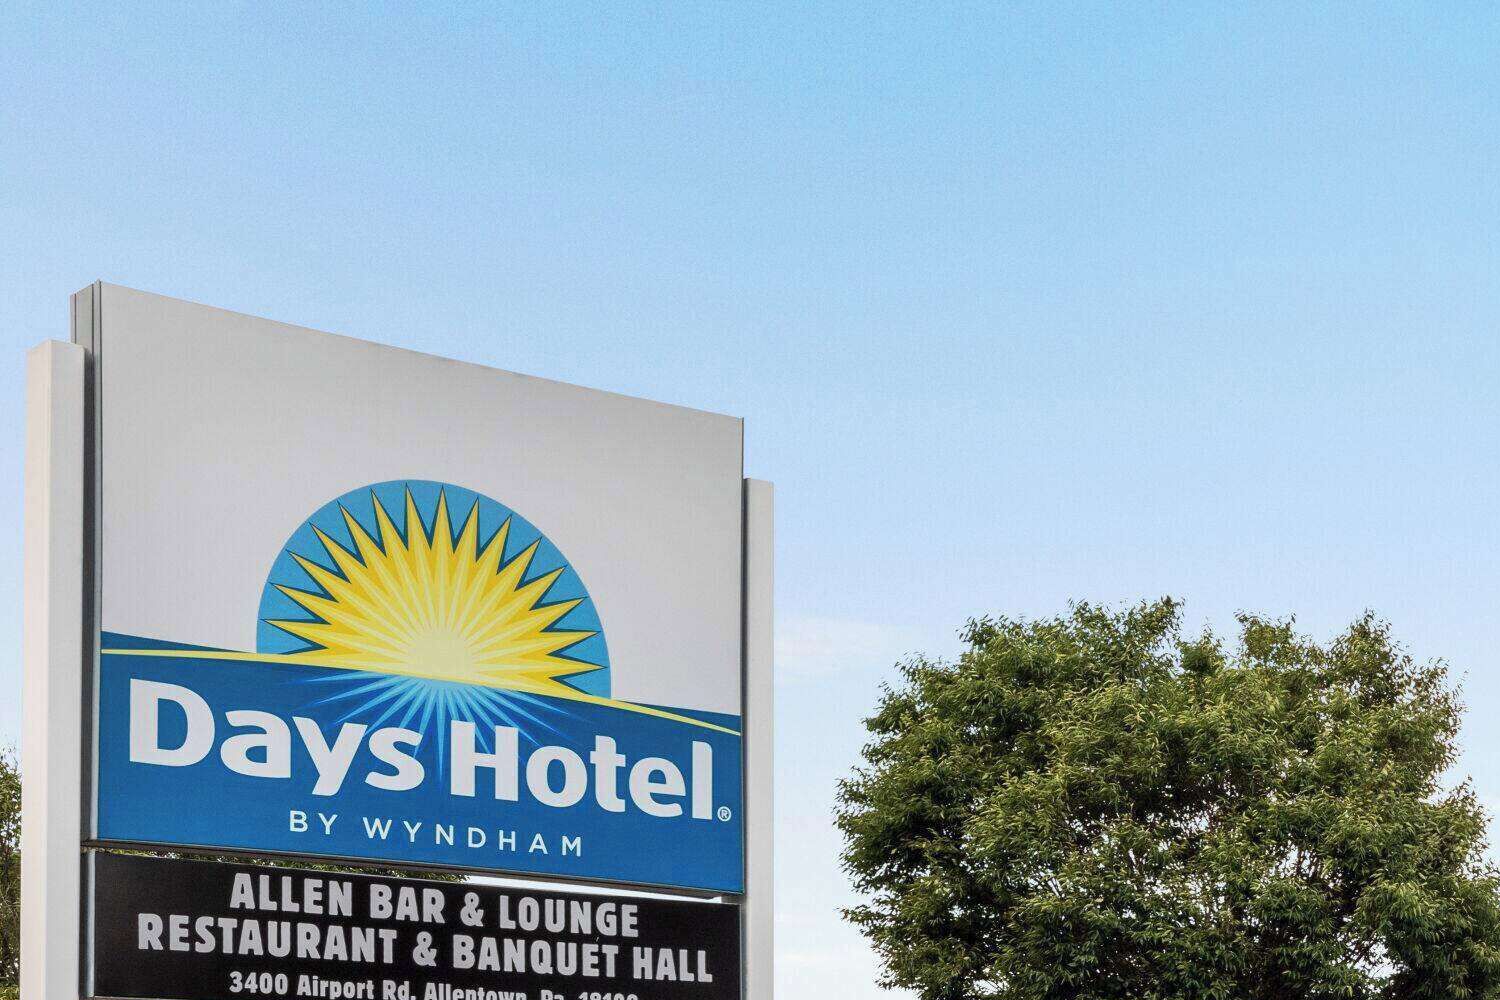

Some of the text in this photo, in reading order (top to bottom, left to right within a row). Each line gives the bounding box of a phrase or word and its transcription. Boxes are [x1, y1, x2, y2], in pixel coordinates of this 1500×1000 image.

[129, 678, 425, 797] Days
[450, 719, 713, 820] Hotel
[289, 810, 582, 857] BY WYNDHAM
[229, 872, 639, 938] ALLEN BAR & LOUNGE
[137, 912, 713, 983] RESTAURANT & BANQUET HALL
[229, 970, 289, 996] 3400
[296, 974, 375, 1000] Airport
